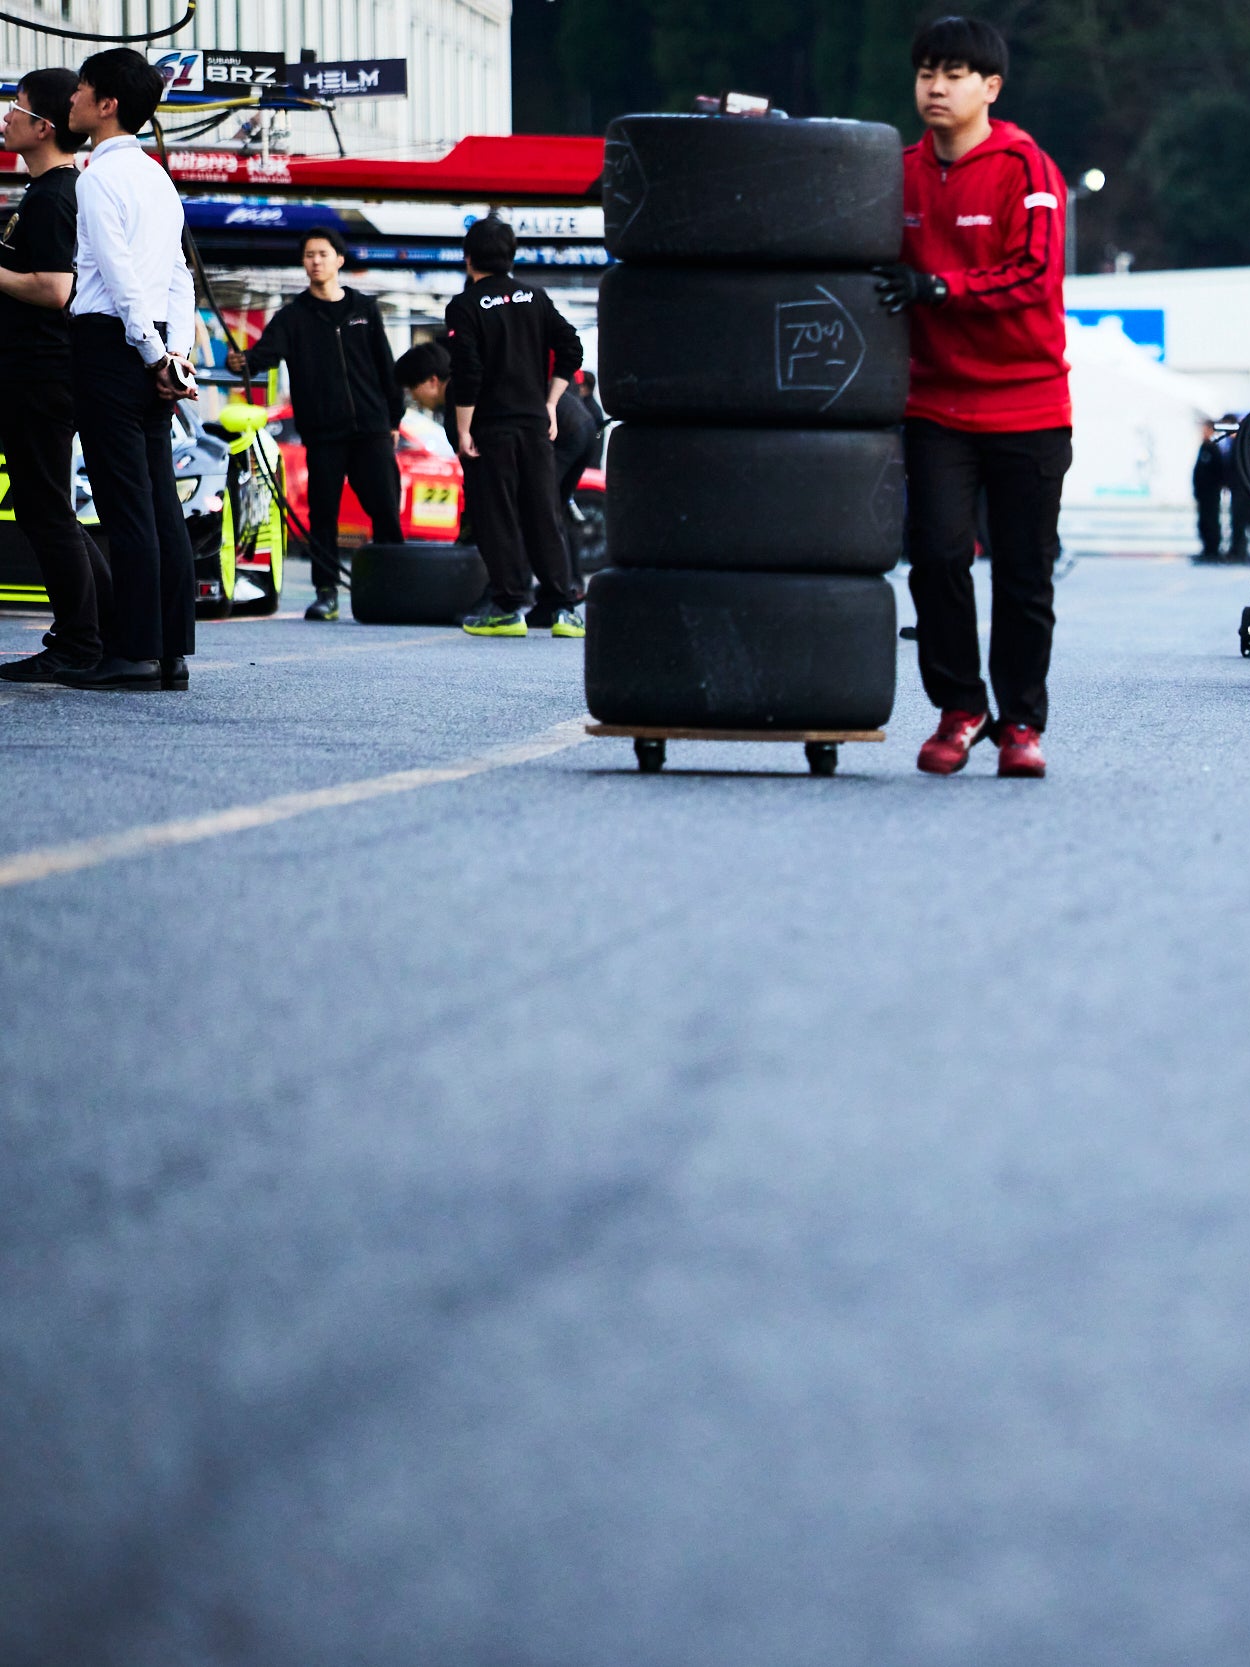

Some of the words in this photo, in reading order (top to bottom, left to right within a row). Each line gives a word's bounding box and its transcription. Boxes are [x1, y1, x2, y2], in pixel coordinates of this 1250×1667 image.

[155, 52, 199, 87] 61
[206, 66, 277, 84] BRZ
[303, 69, 380, 90] HELM
[518, 216, 580, 234] ALIZE
